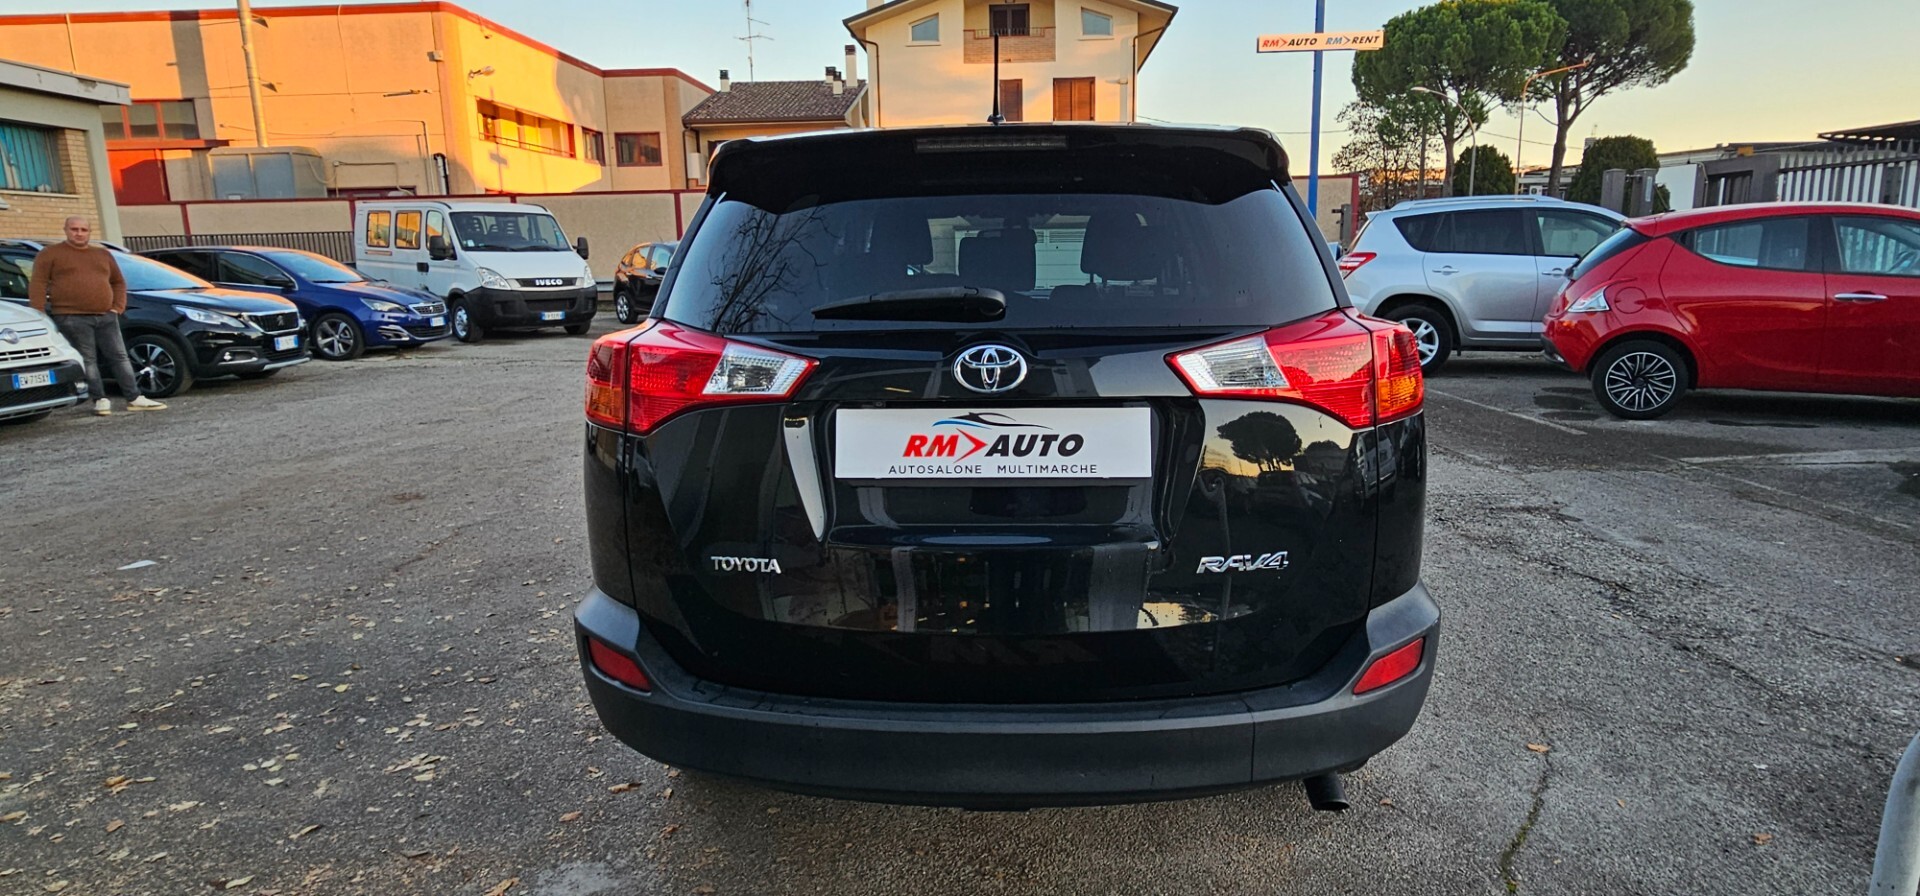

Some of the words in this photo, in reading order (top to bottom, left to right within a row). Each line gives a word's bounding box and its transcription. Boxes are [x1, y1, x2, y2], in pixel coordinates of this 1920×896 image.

[1262, 39, 1279, 47] RM
[1287, 38, 1317, 46] AUTO
[1325, 37, 1342, 45] RM
[1351, 35, 1379, 44] RENT
[535, 278, 563, 286] IVECO
[902, 434, 959, 457] RM
[984, 433, 1084, 457] AUTO
[888, 465, 982, 474] AUTOSALONE
[997, 464, 1097, 474] MULTIMARCHE
[710, 556, 782, 574] TOYOTA
[1196, 551, 1289, 574] RAV4
